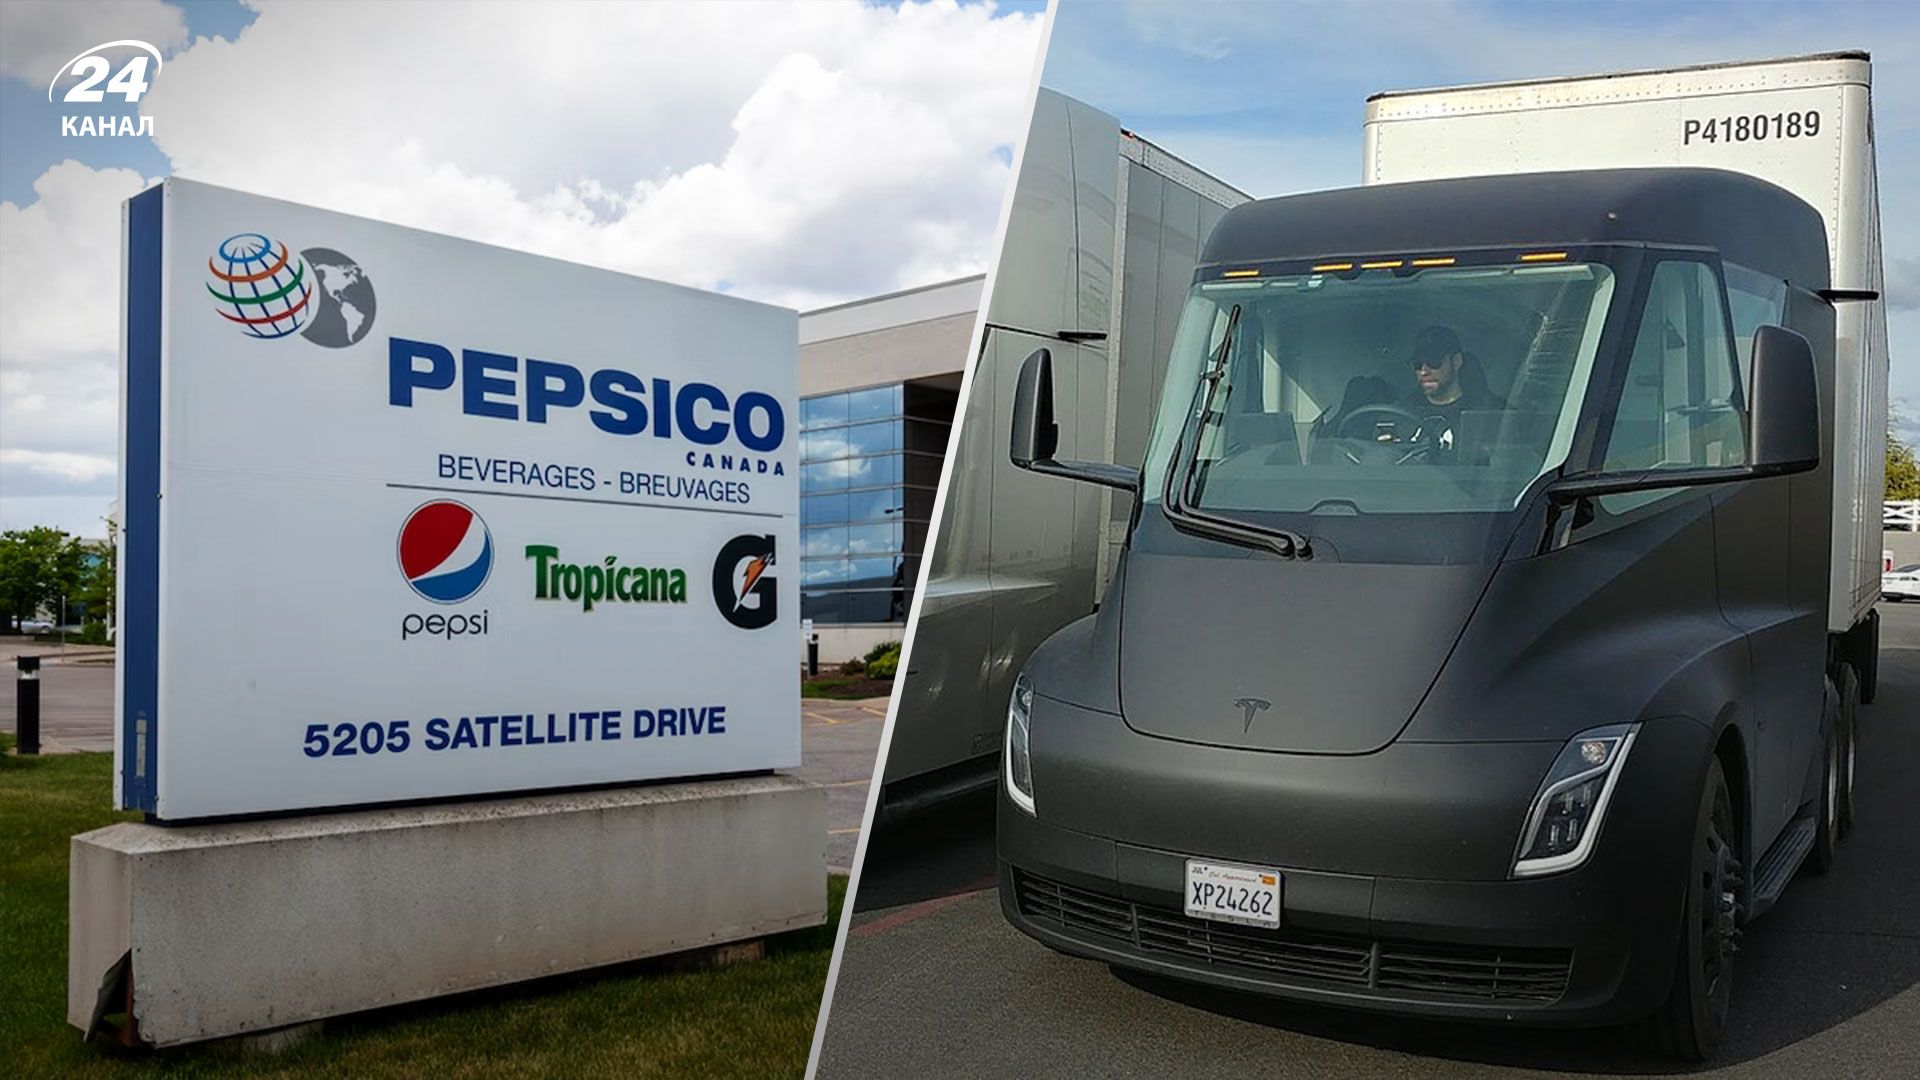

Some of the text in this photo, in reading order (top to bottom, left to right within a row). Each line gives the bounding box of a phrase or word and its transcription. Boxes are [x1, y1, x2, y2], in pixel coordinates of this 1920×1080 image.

[1684, 111, 1821, 146] P4180189
[388, 336, 785, 452] PEPSICO
[438, 454, 596, 491] BEVERAGES
[620, 471, 751, 505] BREUVAGES
[686, 451, 785, 477] CANADA
[525, 544, 687, 613] Tropicana
[712, 534, 778, 630] G
[402, 609, 489, 641] pepsi
[303, 706, 727, 758] 5205 SATELLITE DRIVE
[1192, 881, 1273, 916] XP24262
